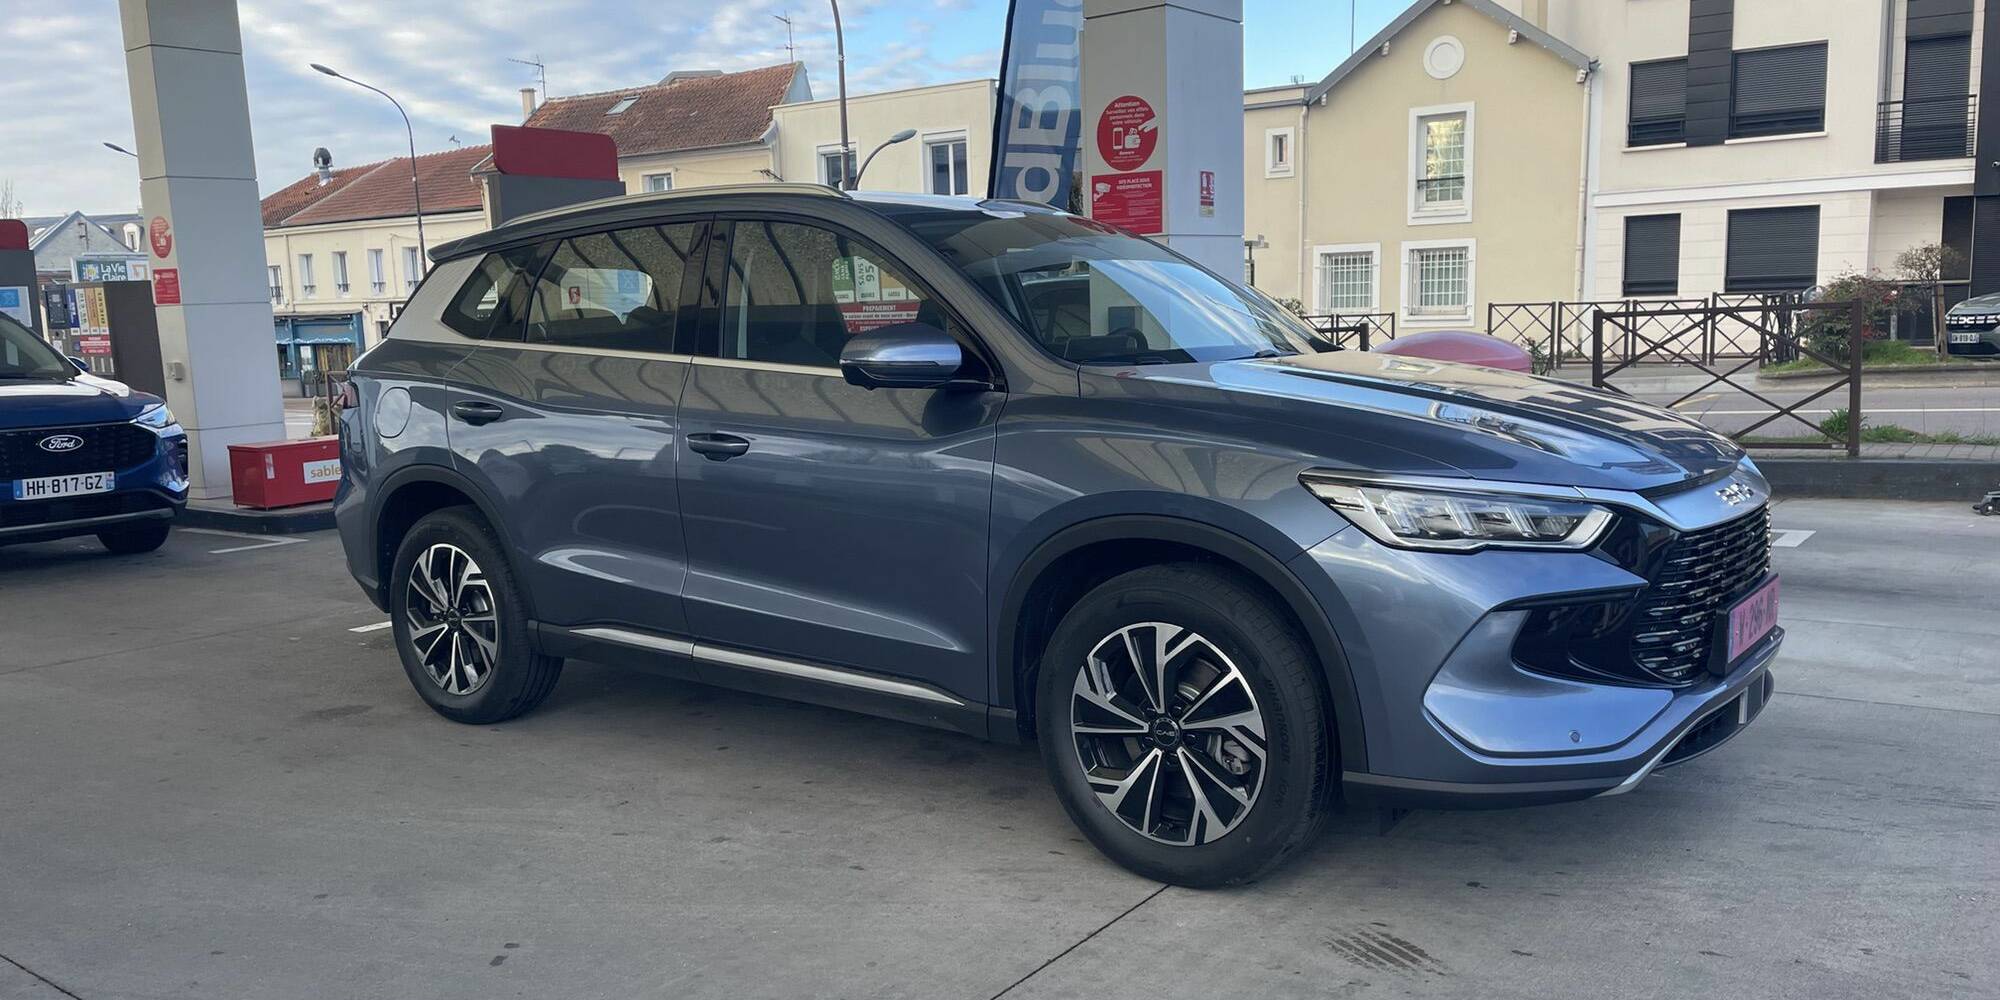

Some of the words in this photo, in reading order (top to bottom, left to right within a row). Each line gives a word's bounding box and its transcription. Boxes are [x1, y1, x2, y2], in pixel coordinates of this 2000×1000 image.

[100, 263, 111, 273] La
[111, 263, 126, 273] Vie
[865, 265, 875, 282] 95
[48, 437, 76, 449] Ford
[310, 464, 341, 478] sable
[26, 475, 104, 496] HH-817-GZ
